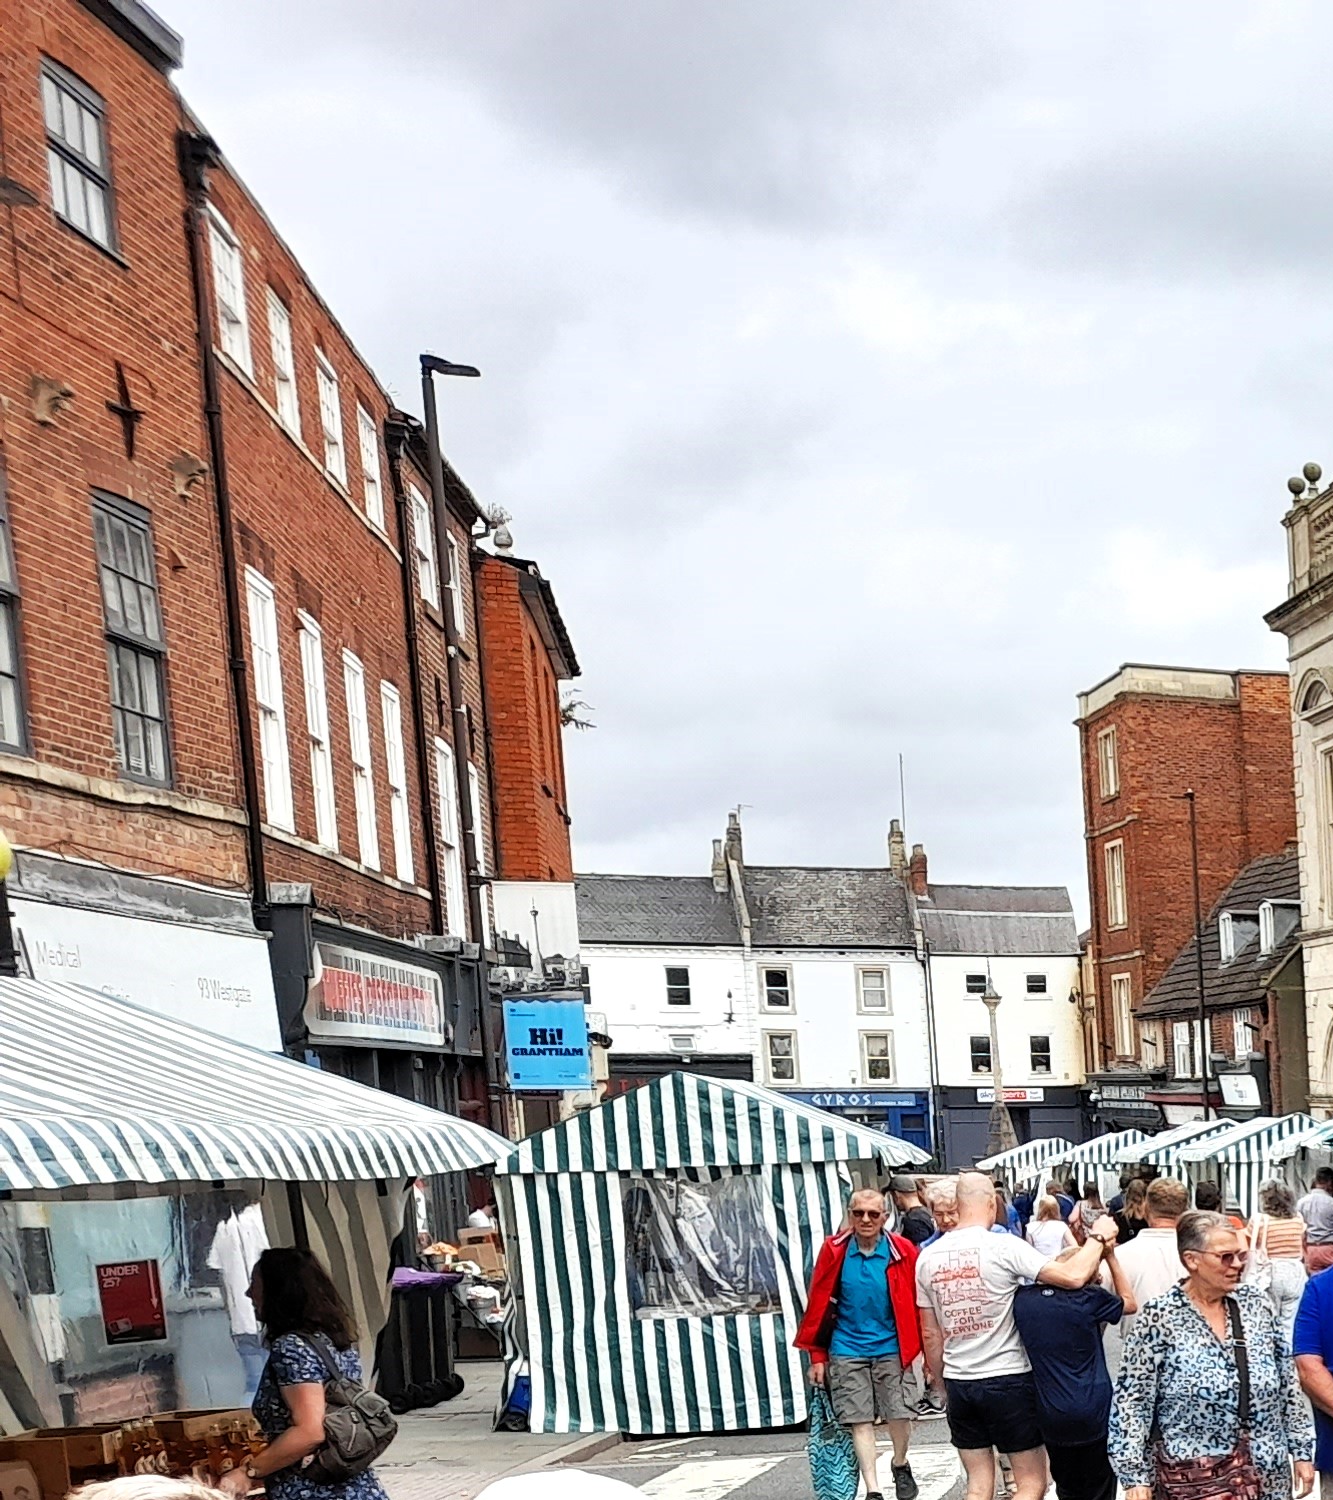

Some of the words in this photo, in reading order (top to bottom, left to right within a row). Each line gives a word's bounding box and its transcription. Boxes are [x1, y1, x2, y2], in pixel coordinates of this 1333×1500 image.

[36, 941, 81, 968] Medical
[209, 980, 251, 1008] Westgate
[529, 1028, 563, 1045] Hi!
[512, 1047, 583, 1057] GRANTHAM
[811, 1093, 872, 1106] GYROS
[100, 1265, 140, 1278] UNDER
[944, 1306, 983, 1318] COFFEE
[954, 1316, 975, 1326] FOR
